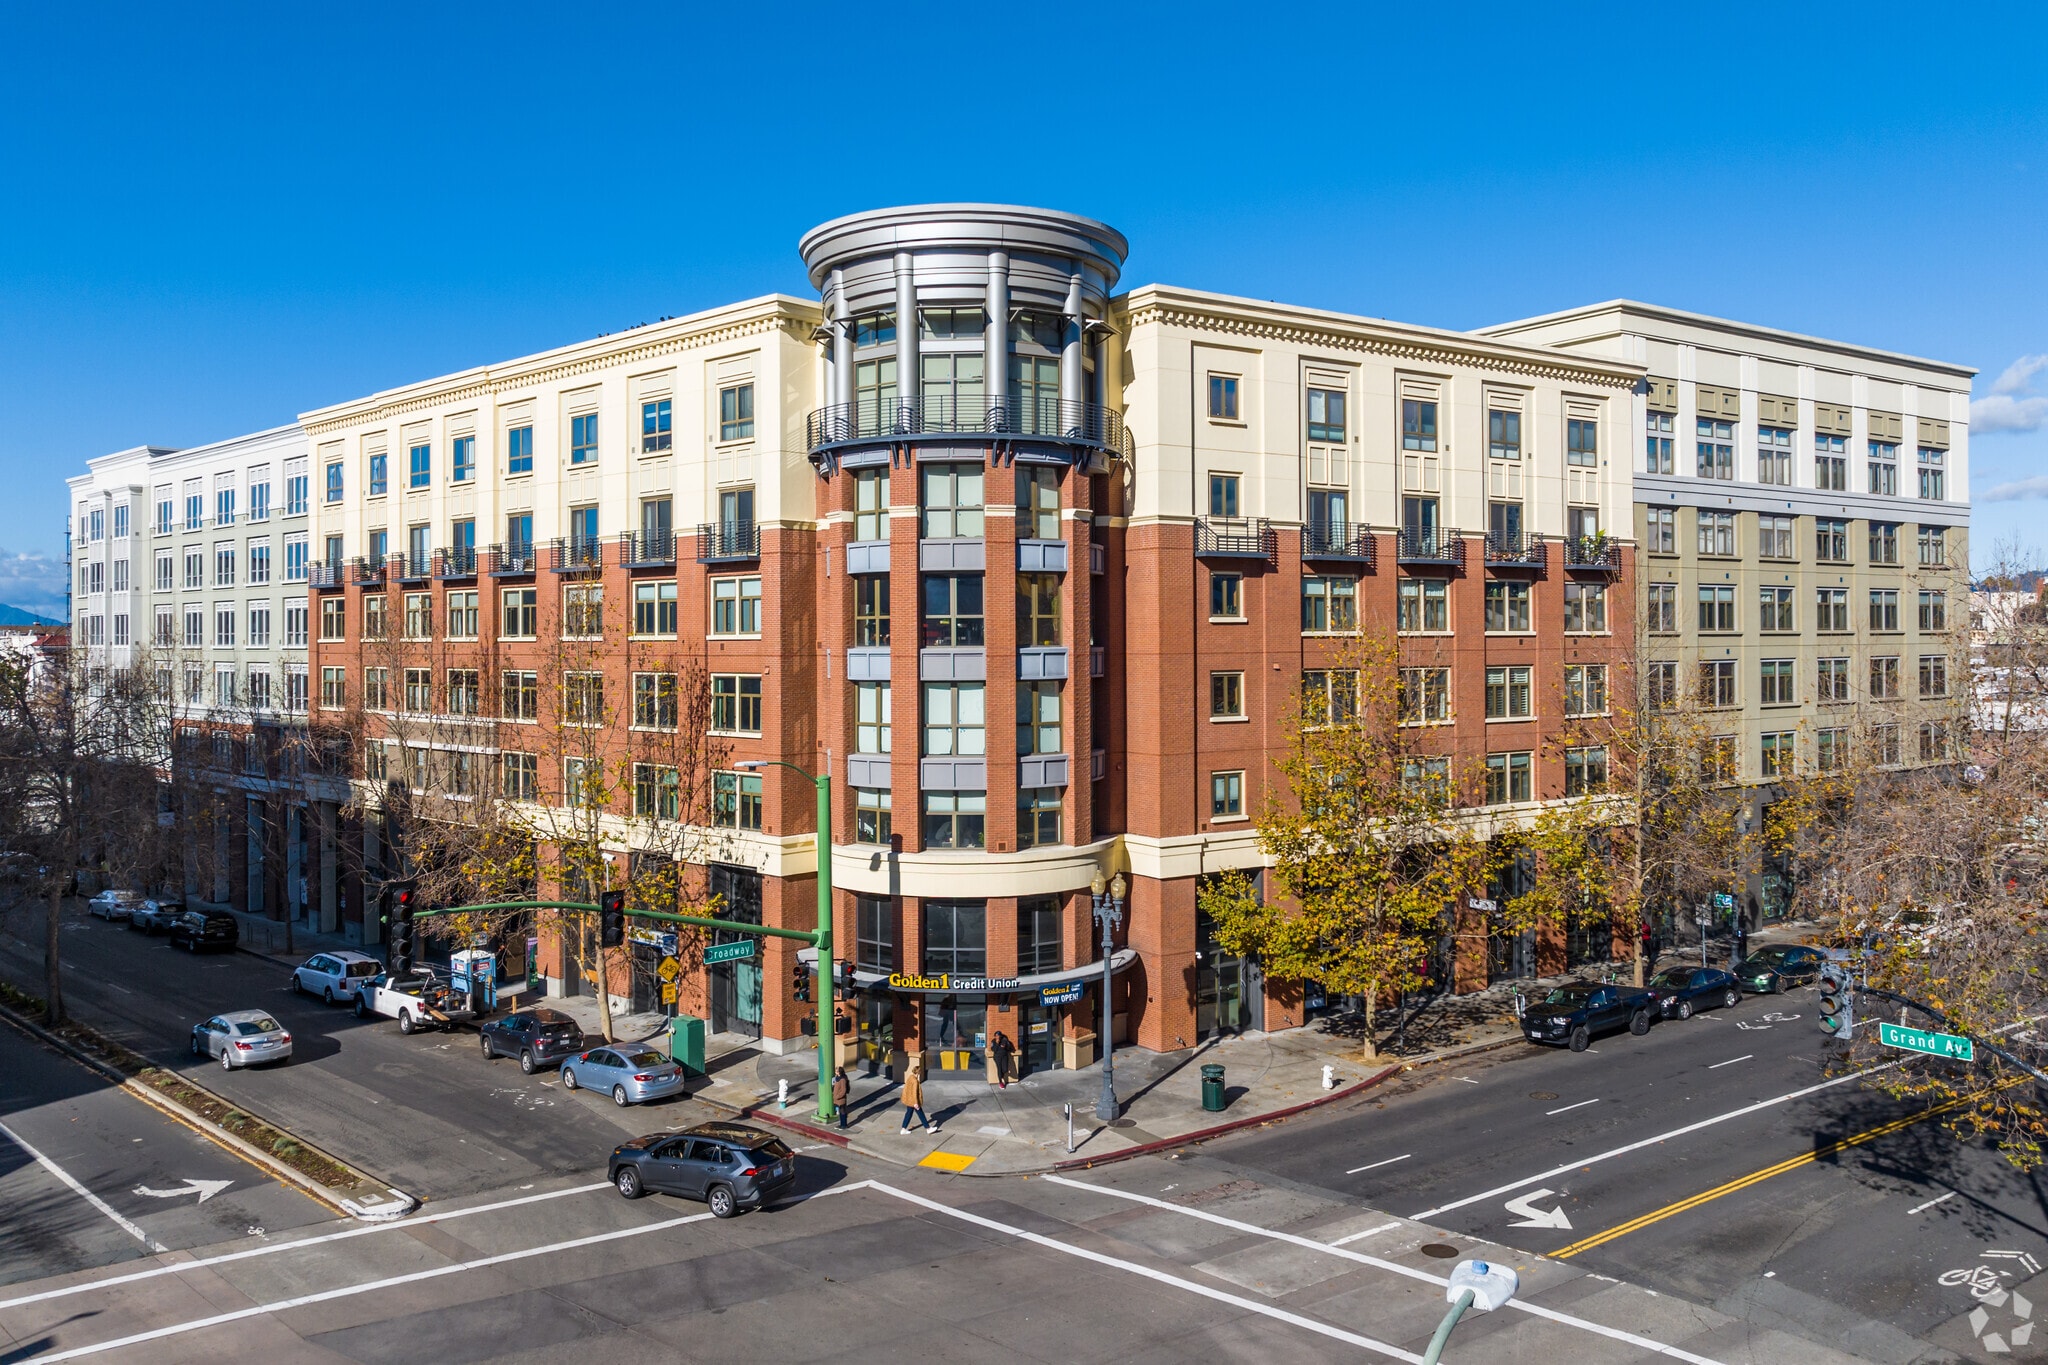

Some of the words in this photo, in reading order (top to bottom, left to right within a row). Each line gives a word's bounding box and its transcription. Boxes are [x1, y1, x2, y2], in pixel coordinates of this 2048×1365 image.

[708, 946, 750, 960] Broadway
[953, 978, 985, 989] Credit
[988, 978, 1018, 989] Union
[1044, 995, 1060, 1005] NOW
[1060, 993, 1079, 1003] OPEN!
[1890, 1029, 1936, 1050] Grand
[1945, 1040, 1963, 1054] Av
